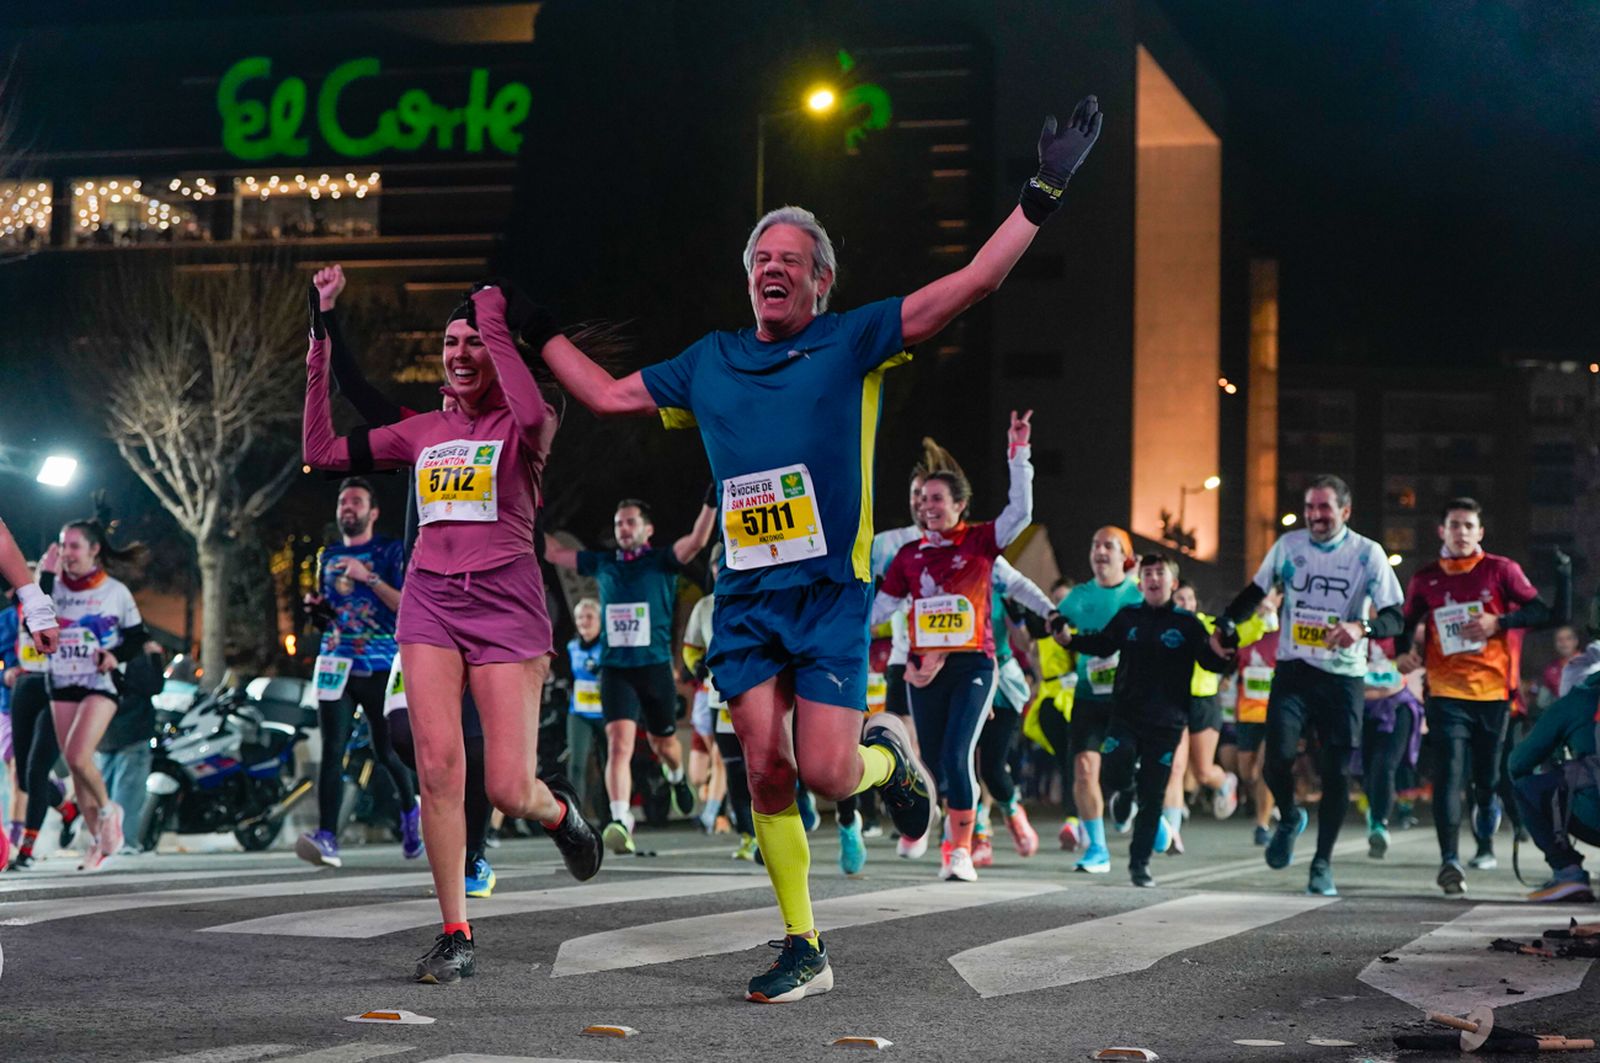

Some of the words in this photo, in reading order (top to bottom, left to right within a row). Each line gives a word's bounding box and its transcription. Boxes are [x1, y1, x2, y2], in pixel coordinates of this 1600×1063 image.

[218, 57, 308, 160] El
[317, 57, 533, 156] Corte
[430, 466, 475, 492] 5712
[738, 484, 760, 496] NOCHE
[762, 481, 773, 491] DE
[732, 498, 744, 510] SAN
[742, 502, 794, 536] 5711
[928, 613, 963, 629] 2275
[60, 645, 88, 660] 5742
